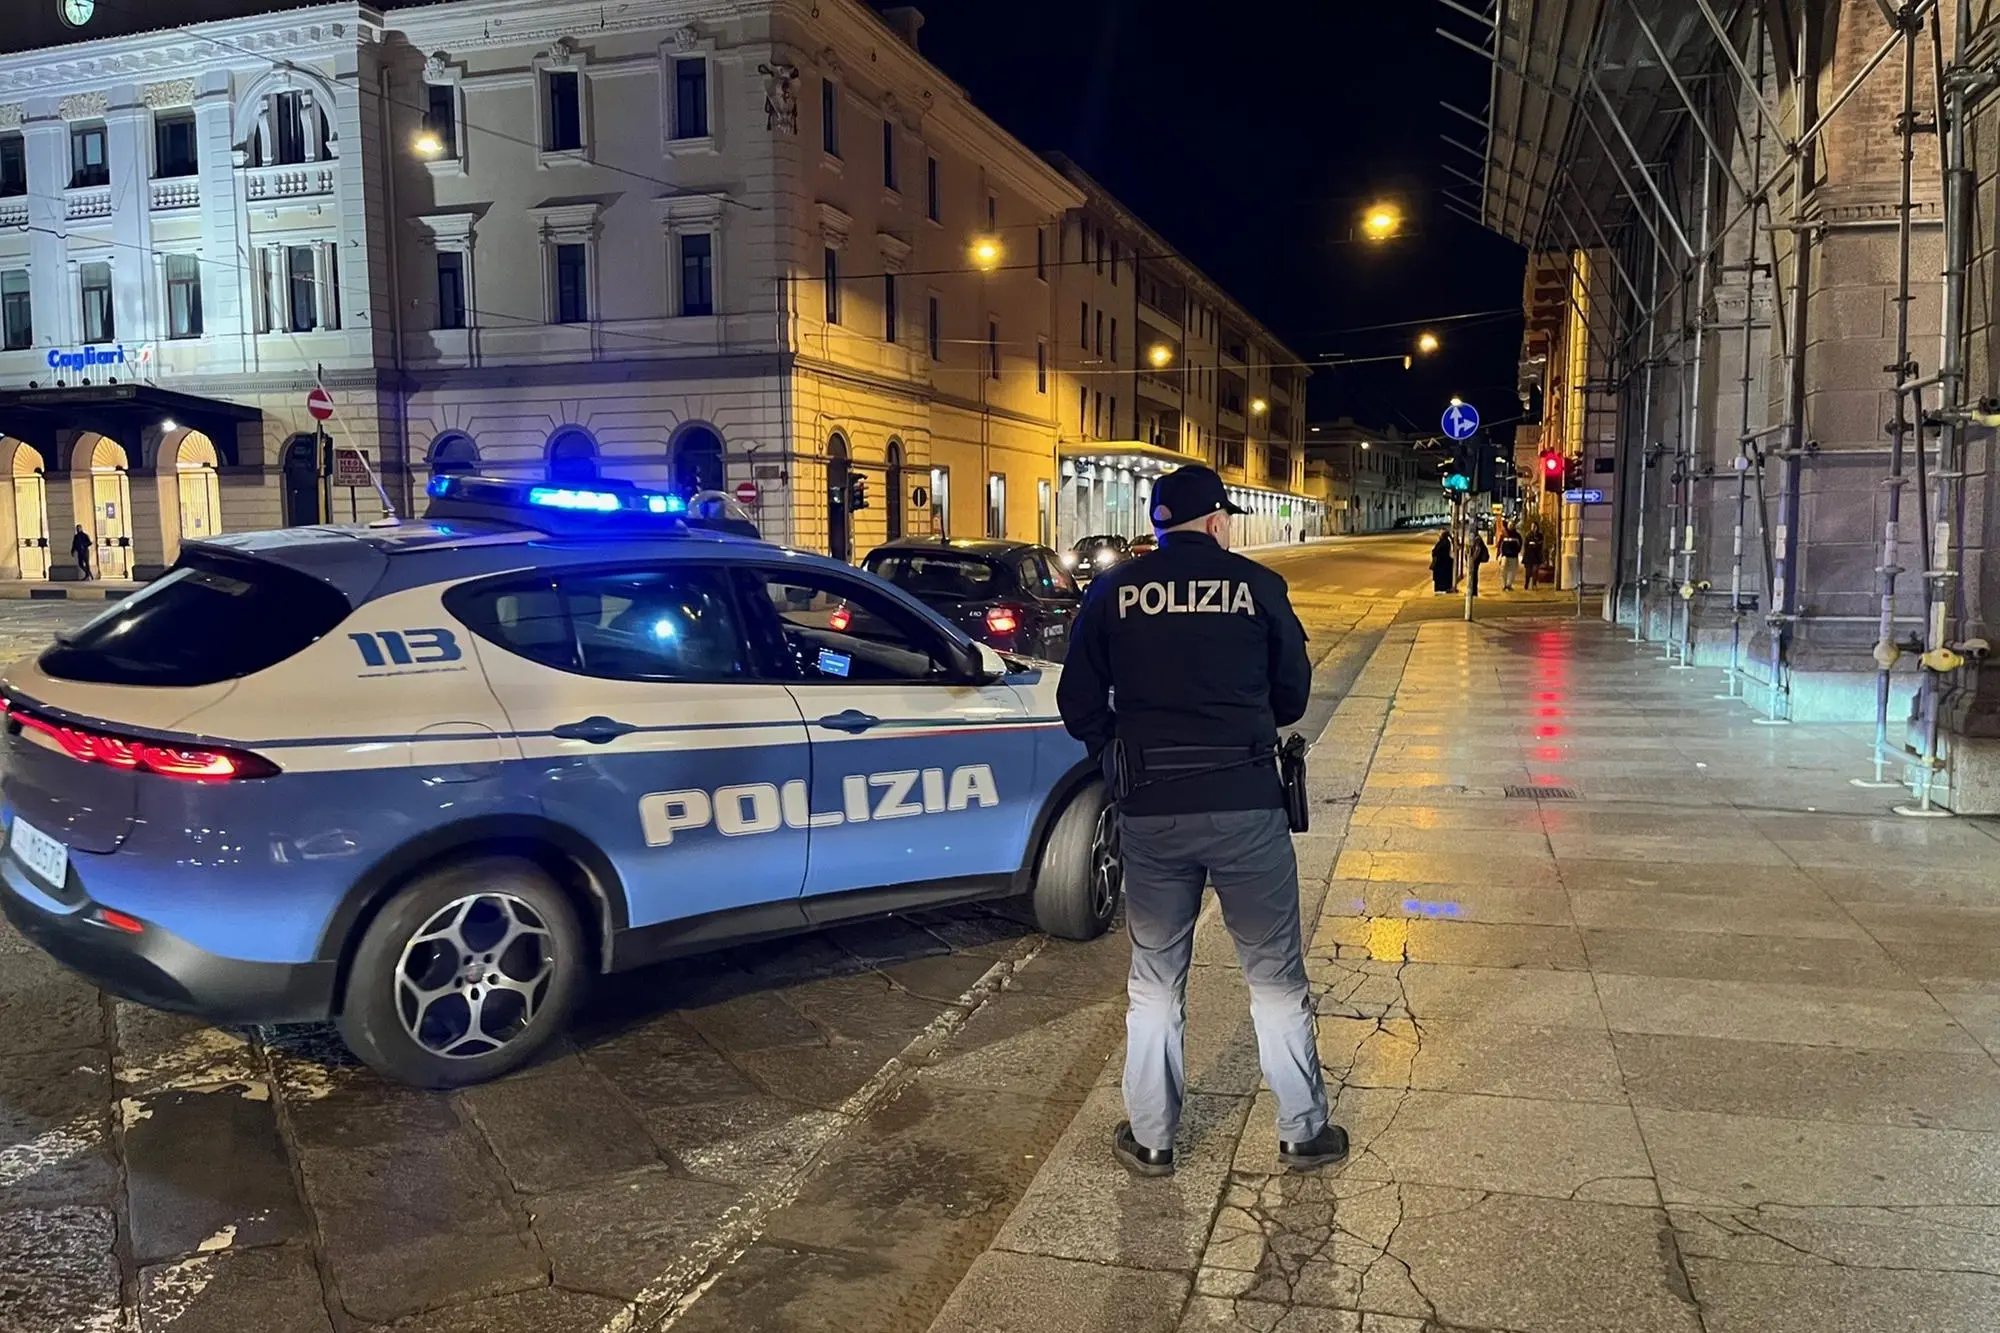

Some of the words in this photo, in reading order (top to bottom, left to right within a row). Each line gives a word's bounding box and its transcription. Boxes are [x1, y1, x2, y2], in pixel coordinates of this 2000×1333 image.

[48, 344, 124, 372] Cagliari
[1118, 580, 1256, 619] POLIZIA
[347, 628, 462, 667] 113
[639, 764, 999, 848] POLIZIA
